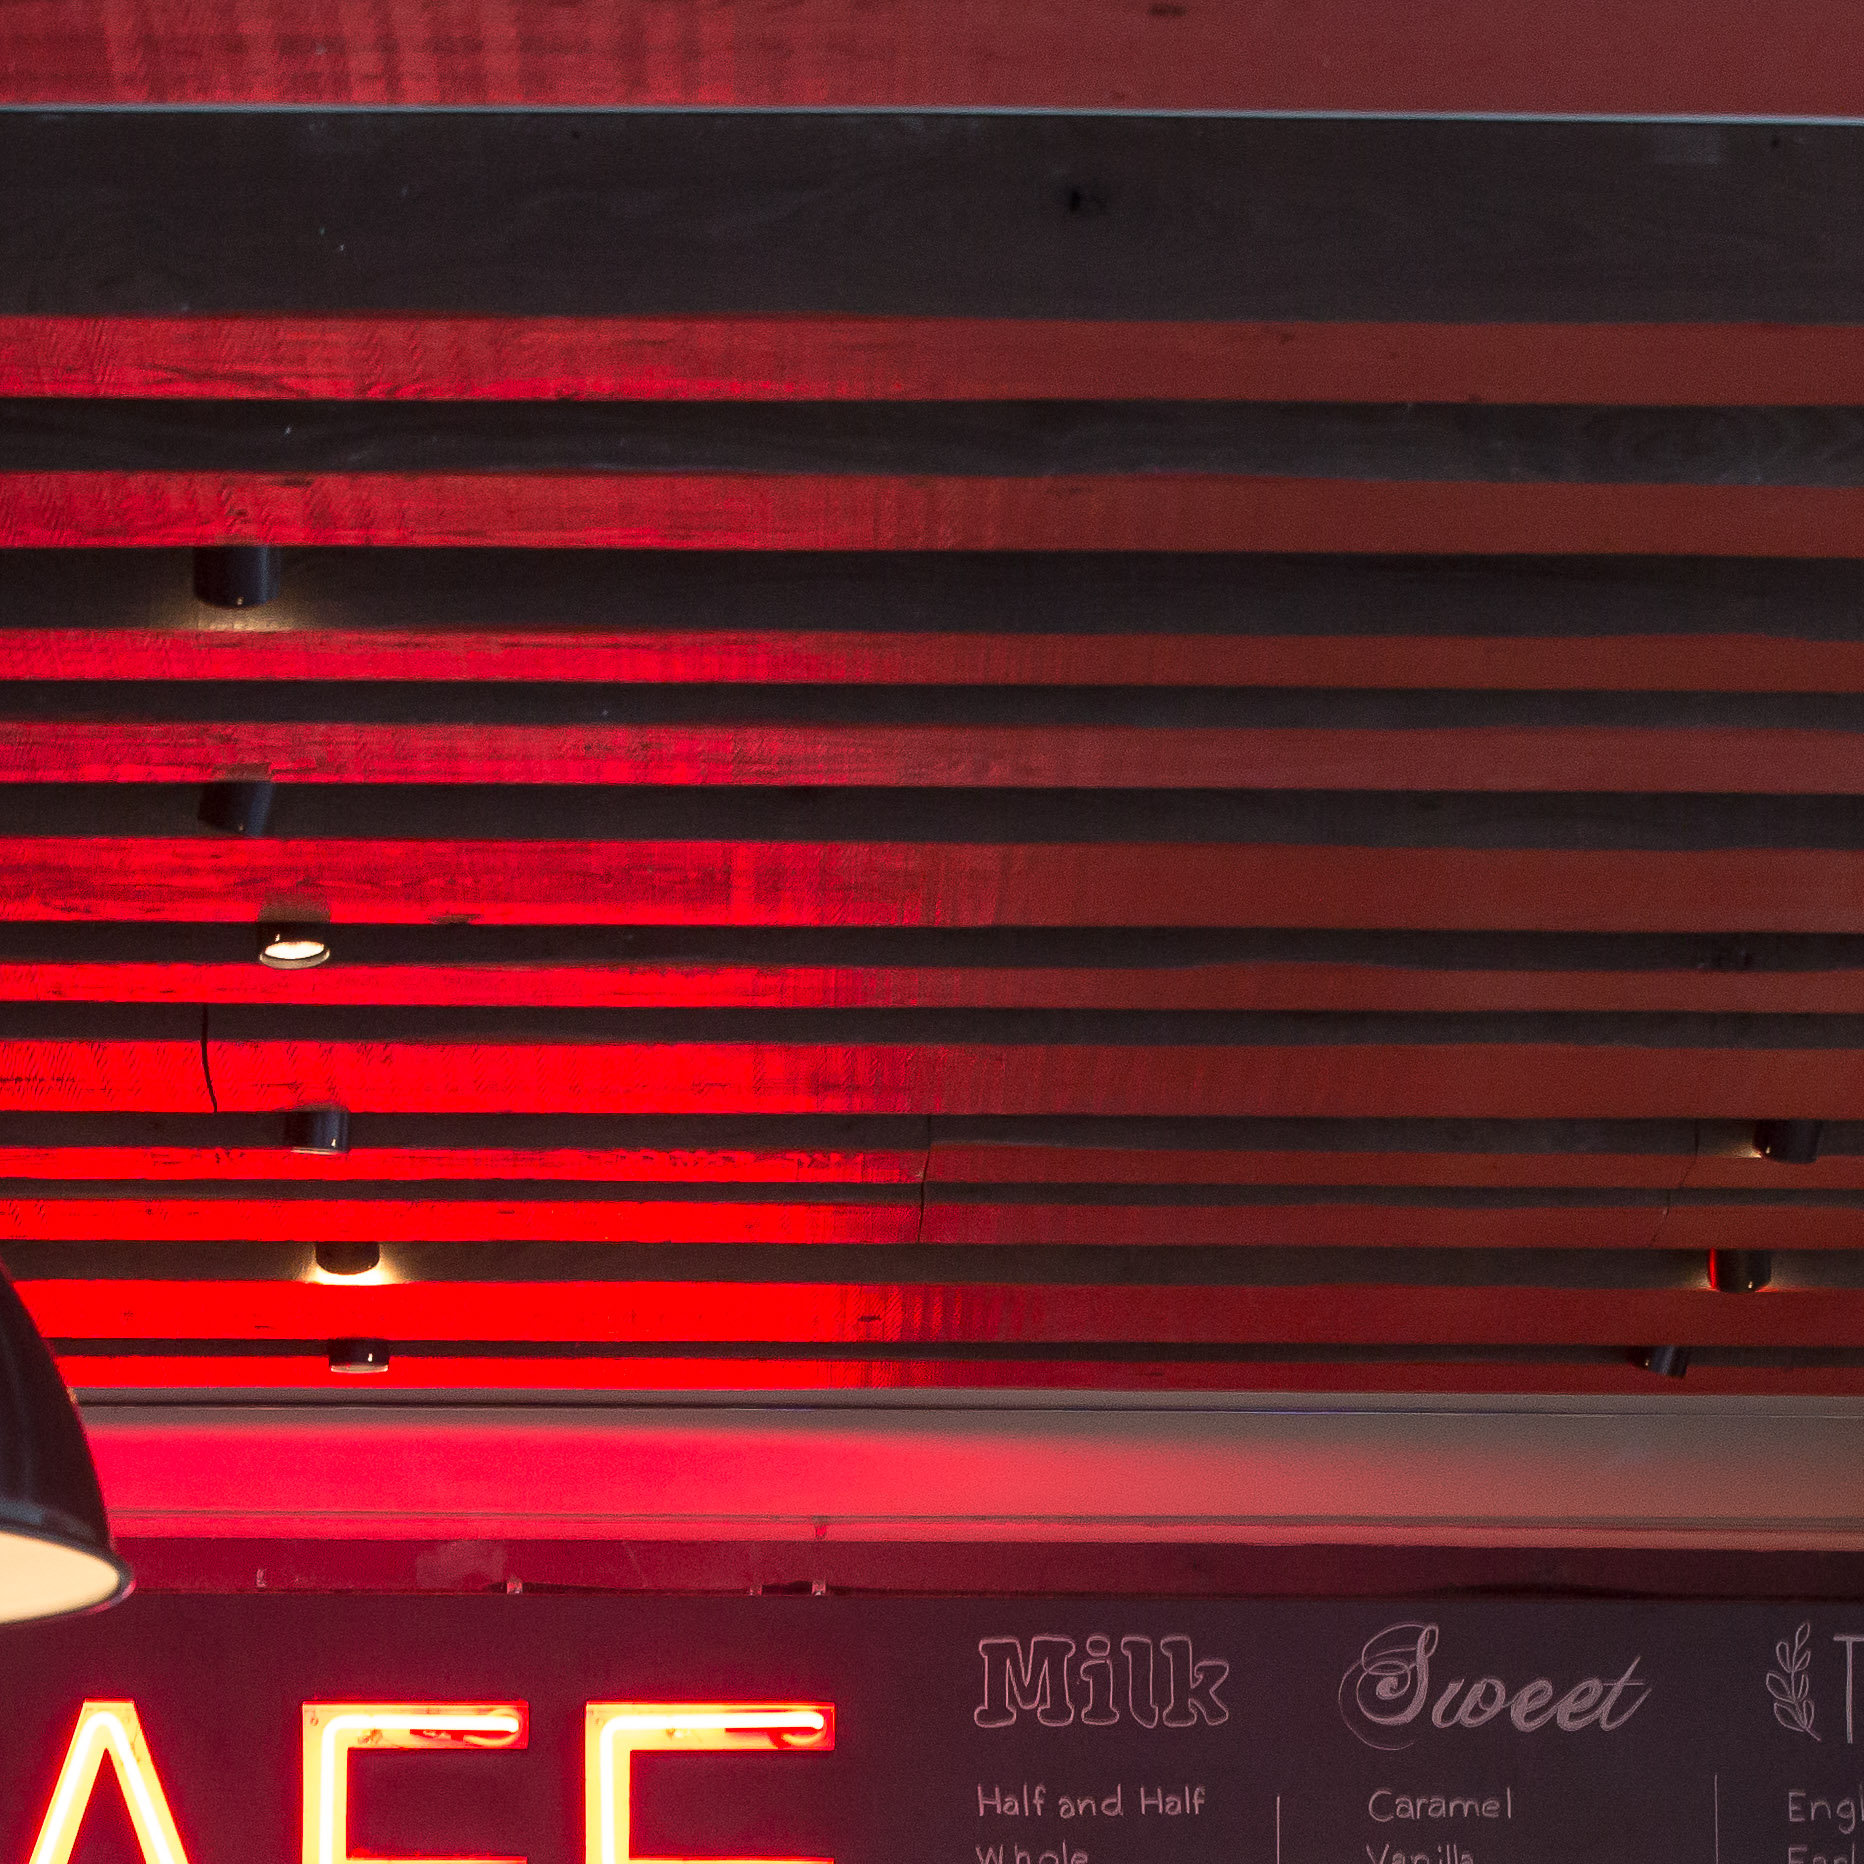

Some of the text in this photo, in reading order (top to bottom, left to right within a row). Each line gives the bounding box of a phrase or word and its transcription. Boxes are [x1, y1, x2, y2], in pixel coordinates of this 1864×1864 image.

[973, 1633, 1229, 1729] Milk
[1338, 1622, 1651, 1750] Sweet
[977, 1784, 1204, 1819] Half and Half
[1368, 1787, 1512, 1822] Caramel
